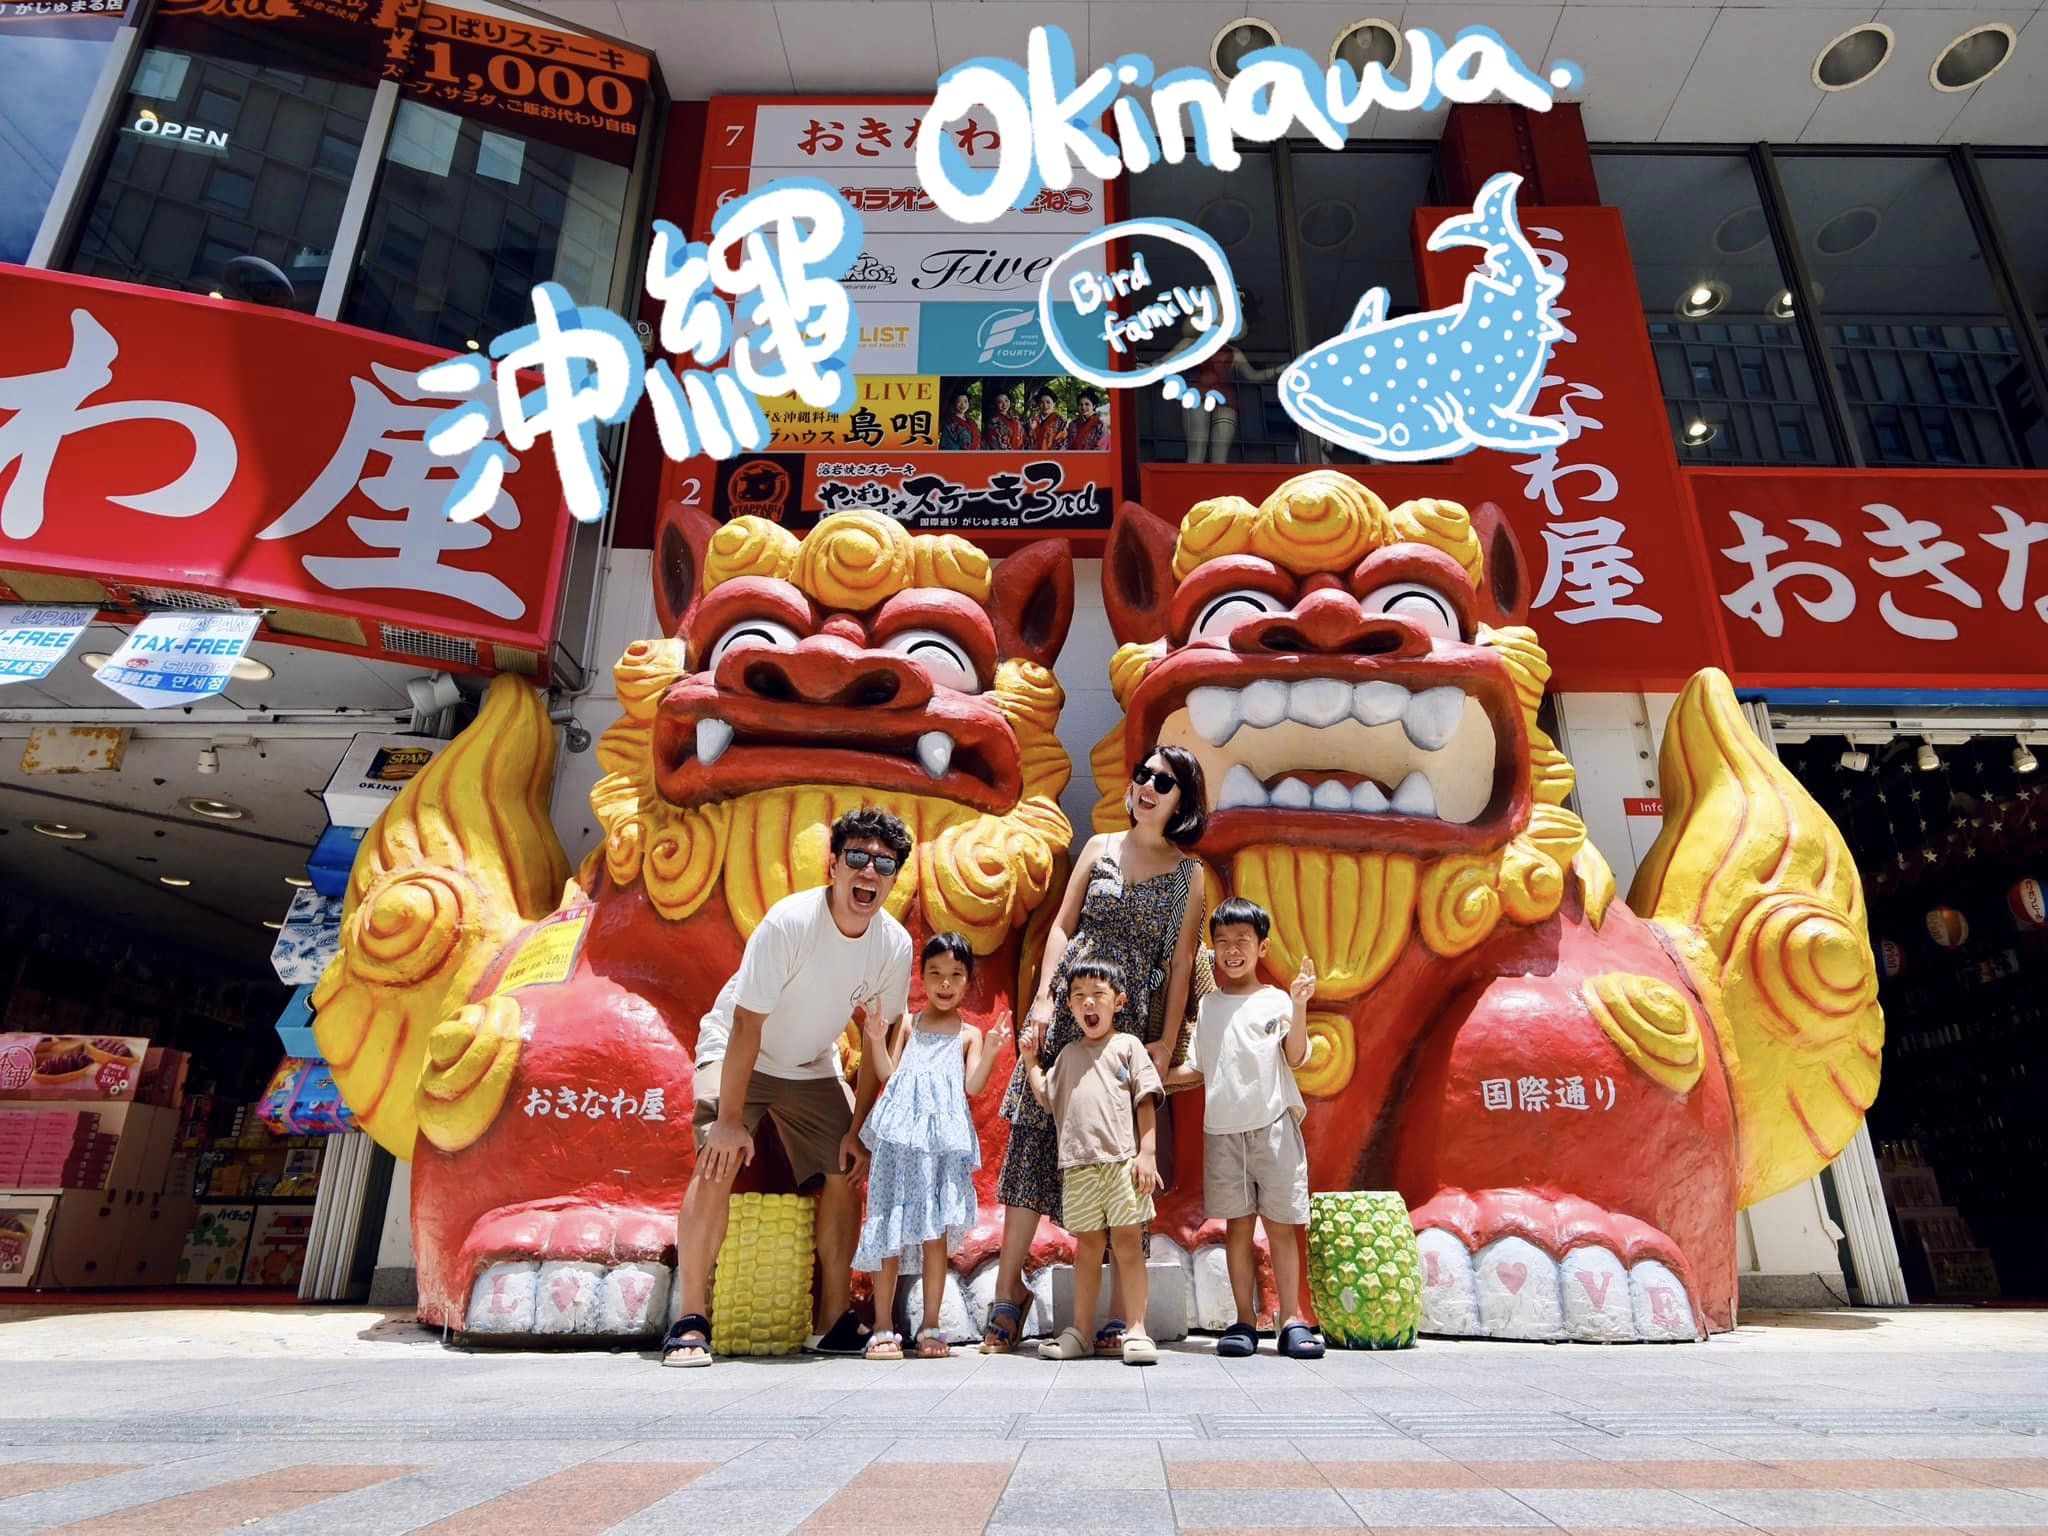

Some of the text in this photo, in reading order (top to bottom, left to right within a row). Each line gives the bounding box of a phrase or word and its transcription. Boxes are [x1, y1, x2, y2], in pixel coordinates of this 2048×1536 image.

[135, 117, 229, 147] OPEN
[725, 125, 745, 147] 7
[912, 249, 1053, 290] Five
[865, 383, 932, 400] LIVE
[764, 410, 840, 424] &沖縄料理
[843, 406, 935, 449] 島唄
[817, 463, 916, 476] 溶岩焼きステーキ
[681, 478, 702, 505] 2
[920, 517, 958, 527] 国際通り
[0, 630, 75, 648] -FREE
[131, 634, 244, 656] TAX-FREE
[161, 660, 230, 675] SHOP
[388, 753, 430, 765] SPAM
[522, 1087, 668, 1123] おきなわ屋
[1481, 1075, 1617, 1113] 国際通り
